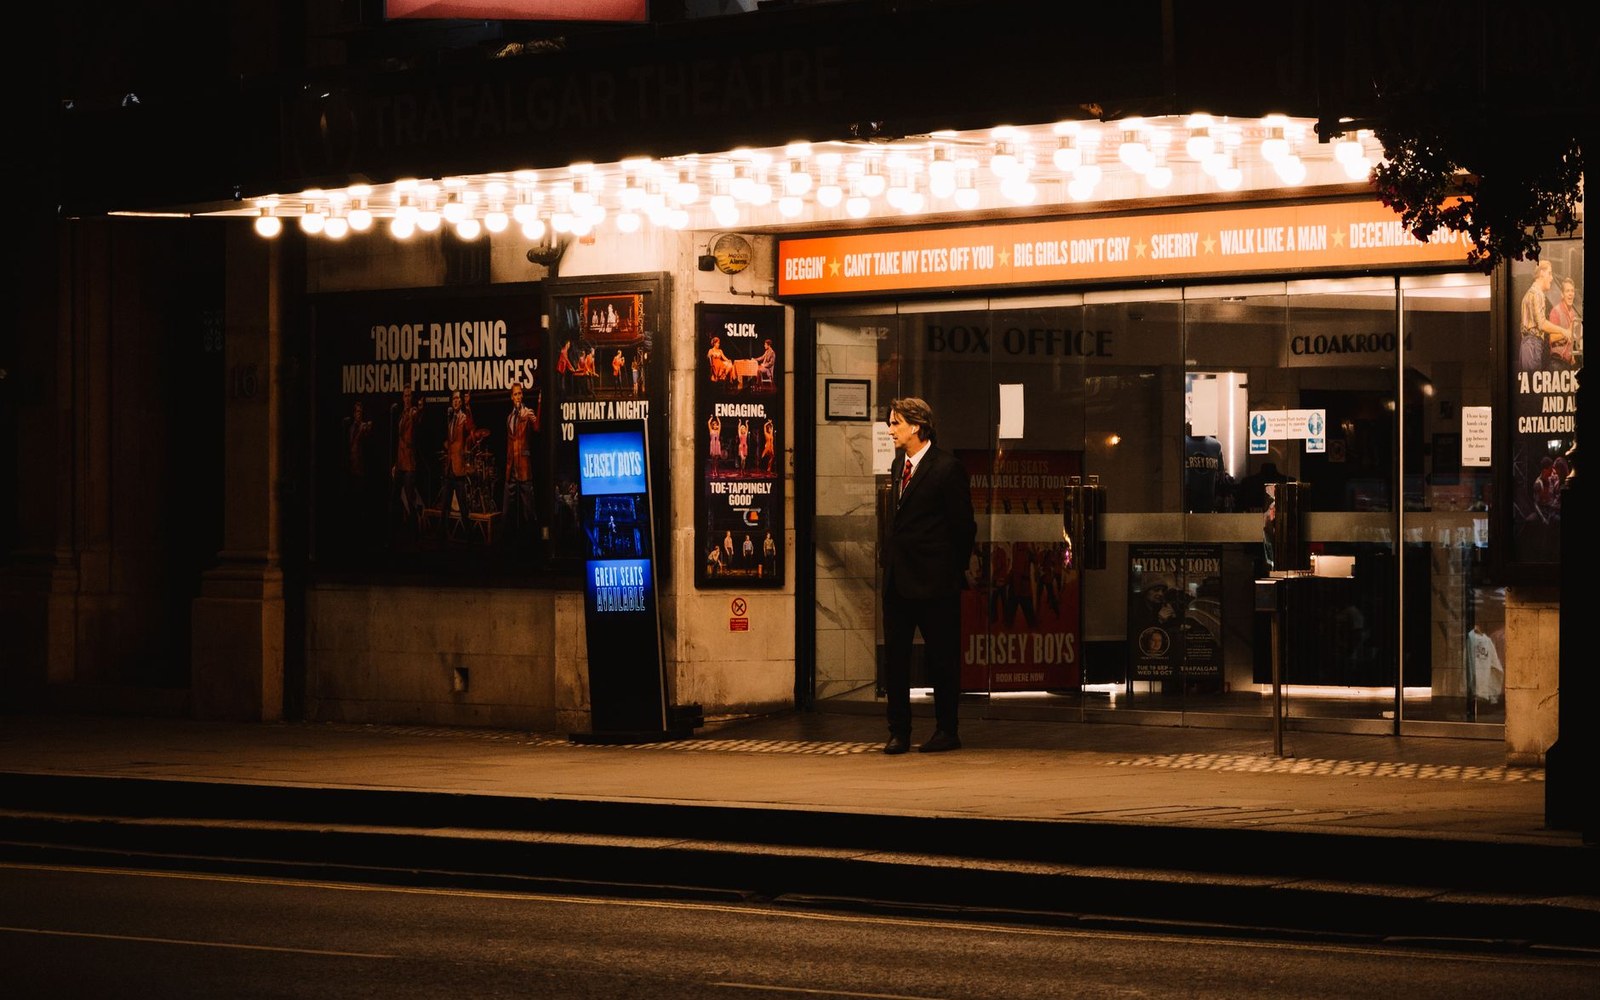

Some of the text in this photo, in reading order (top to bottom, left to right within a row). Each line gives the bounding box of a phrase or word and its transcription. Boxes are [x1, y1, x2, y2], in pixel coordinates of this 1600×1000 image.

[374, 45, 843, 147] TRAFALGAR THEATRE
[785, 256, 826, 281] BEGGIN'
[844, 252, 871, 278] CANT
[873, 250, 900, 276] TAKE
[902, 249, 919, 274] MY
[921, 248, 948, 273] EYES
[950, 246, 970, 271] OFF
[971, 245, 994, 269] YOU
[1013, 242, 1033, 267] BIG
[1035, 240, 1069, 267] GIRLS
[1070, 237, 1105, 264] DON'T
[1106, 236, 1131, 262] CRY
[1151, 232, 1199, 260] SHERRY
[1220, 229, 1255, 256] WALK
[1257, 226, 1285, 254] LIKE
[1286, 226, 1295, 251] A
[1297, 224, 1327, 251] MAN
[1349, 219, 1423, 248] DECEMBE,
[371, 319, 507, 361] 'ROOF-RAISING
[928, 325, 1114, 357] BOX OFFICE
[342, 358, 538, 394] MUSICAL PERFORMANCES'
[560, 400, 649, 420] 'OH WHAT A NIGHT!
[715, 403, 767, 419] ENGAGING,
[1542, 395, 1565, 413] AND
[583, 451, 642, 479] JERSEY BOYS
[1021, 460, 1049, 473] SEATS
[710, 482, 772, 494] TOE-TAPPINGLY
[969, 474, 1021, 489] AVALABLE
[1021, 474, 1040, 489] FOR
[728, 494, 754, 506] GOOD'
[595, 565, 643, 587] GREAT SEATS
[596, 586, 646, 612] AVAILABLE
[964, 632, 1075, 666] JERSEY BOYS
[995, 672, 1045, 682] BOOK HERE NOW
